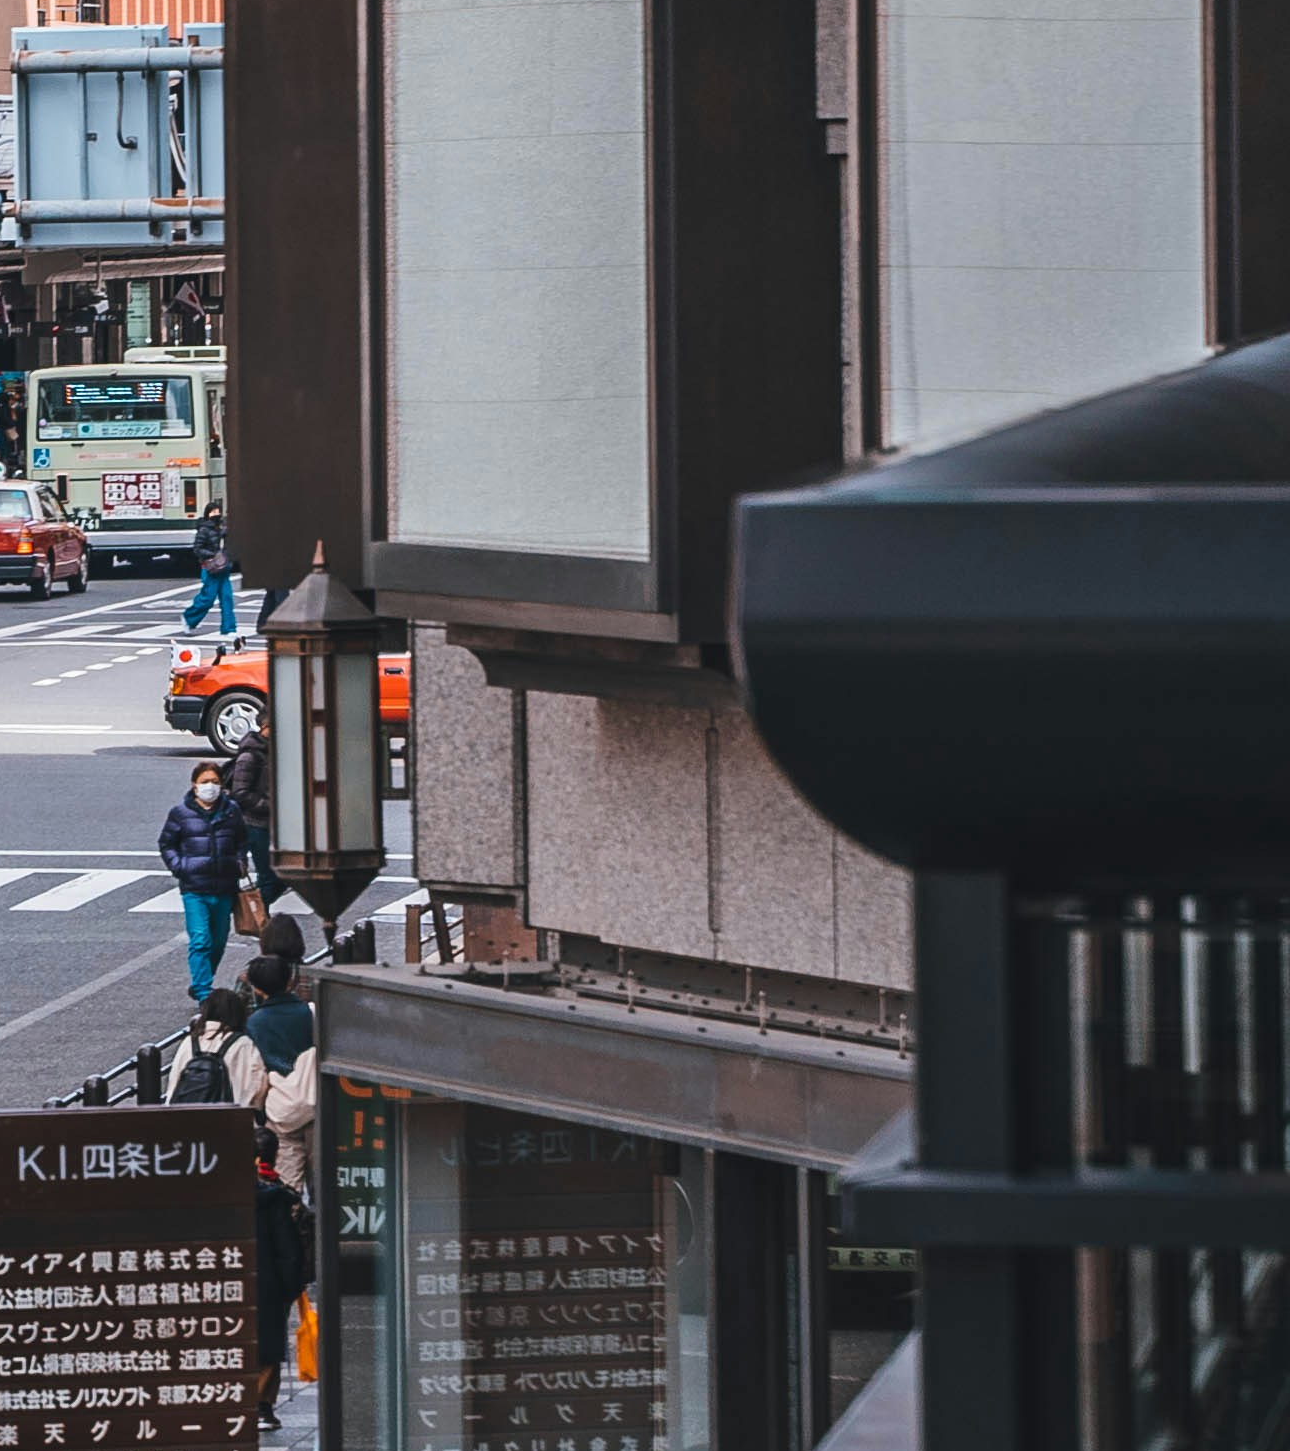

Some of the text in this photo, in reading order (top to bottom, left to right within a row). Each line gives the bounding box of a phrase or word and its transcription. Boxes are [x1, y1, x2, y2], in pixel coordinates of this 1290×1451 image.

[132, 1316, 244, 1340] 京都サロン
[157, 1382, 245, 1406] 京都スタジオ
